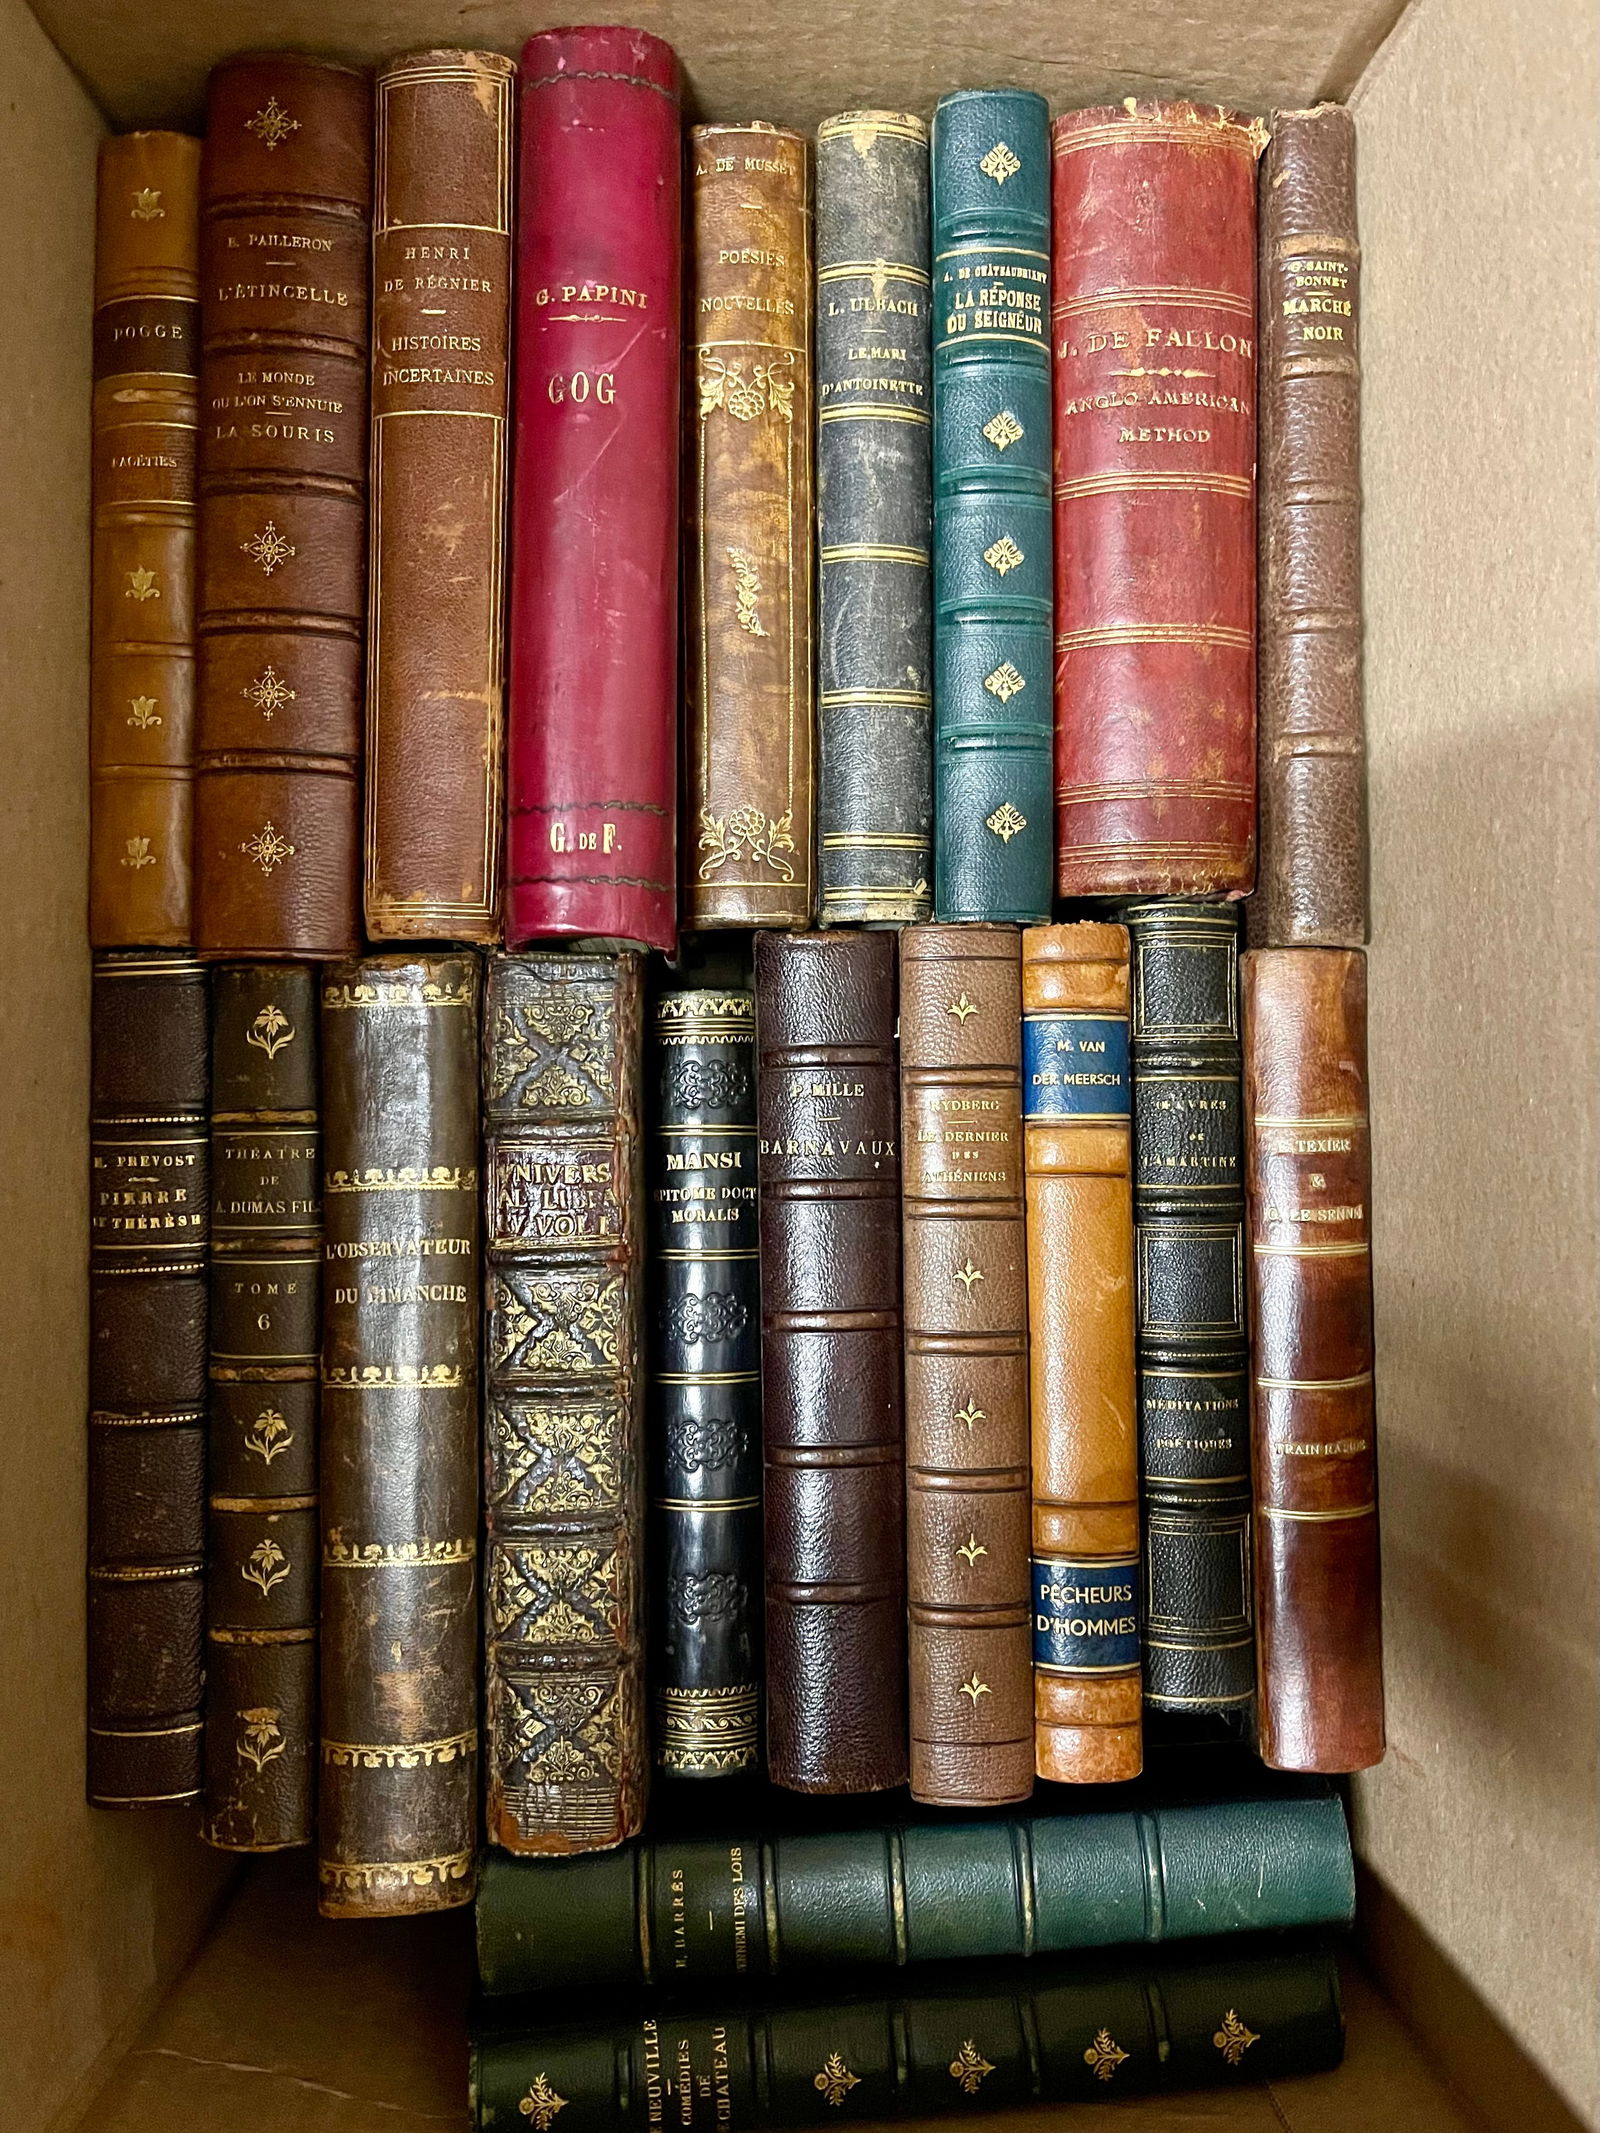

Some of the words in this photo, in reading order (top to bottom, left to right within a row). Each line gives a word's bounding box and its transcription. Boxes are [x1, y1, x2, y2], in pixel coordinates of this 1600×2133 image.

[695, 164, 708, 176] A.
[715, 156, 735, 172] DE
[744, 160, 796, 177] MUSSET
[249, 234, 336, 252] PAILLERON
[404, 246, 471, 260] HENRI
[384, 279, 404, 292] DE
[414, 274, 492, 293] RÉGNIER
[943, 271, 954, 282] A.
[958, 267, 971, 280] DE
[1295, 275, 1348, 288] BONNET
[218, 283, 348, 306] L'ÉTINCELLE
[536, 288, 556, 306] G.
[561, 285, 648, 309] PAPINI
[955, 290, 975, 310] LA
[979, 285, 1041, 312] RÉPONSE
[700, 297, 794, 315] NOUVELLES
[828, 302, 844, 316] L.
[850, 297, 918, 317] ULBACH
[946, 313, 967, 334] DU
[974, 310, 1042, 335] SEIGNEUR
[114, 325, 183, 341] POGGE
[1303, 326, 1344, 341] NOIR
[391, 336, 481, 352] HISTOIRES
[1058, 340, 1079, 359] J.
[1087, 331, 1130, 354] DE
[1145, 328, 1252, 359] FALLON
[848, 349, 869, 361] LE
[871, 348, 907, 361] MARI
[238, 371, 257, 384] LE
[262, 371, 315, 386] MONDE
[382, 368, 495, 386] INCERTAINES
[547, 371, 617, 405] GOG
[822, 377, 924, 397] D'ANTOINETTE
[212, 398, 229, 409] OU
[234, 395, 266, 408] L'ON
[272, 395, 343, 414] S'ENNUIE
[216, 425, 239, 439] LA
[251, 424, 335, 443] SOURIS
[1118, 427, 1211, 443] METHOD
[550, 822, 574, 853] G.
[579, 832, 597, 851] DE
[603, 823, 623, 854] F.
[1057, 1041, 1074, 1052] M.
[1079, 1041, 1105, 1053] VAN
[1032, 1073, 1060, 1086] DER
[1063, 1073, 1121, 1086] MEERSCH
[812, 1083, 864, 1097] MILLE
[917, 1131, 938, 1142] LE
[944, 1131, 1009, 1143] DERNIER
[1296, 1138, 1351, 1153] TEXIER
[760, 1139, 896, 1156] BARNAVAUX
[666, 1151, 742, 1171] MANSI
[259, 1176, 280, 1186] DE
[921, 1170, 1006, 1182] ATHÉNIENS
[100, 1188, 187, 1205] PIERRE
[498, 1187, 528, 1209] AL
[230, 1200, 286, 1214] DUMAS
[671, 1207, 739, 1223] MORALIS
[326, 1238, 471, 1260] L'OBSERVATEUR
[234, 1281, 298, 1295] TOME
[335, 1288, 359, 1304] DU
[257, 1313, 271, 1330] 6
[1274, 1440, 1320, 1455] TRAIN
[1040, 1583, 1132, 1604] PÊCHEURS
[1037, 1614, 1136, 1637] D'HOMMES
[730, 1847, 743, 1882] LOIS
[732, 1886, 746, 1917] DES
[643, 2019, 662, 2122] NEUVILLE
[712, 2026, 731, 2121] CHATEAU
[674, 2039, 692, 2126] COMÉDIES
